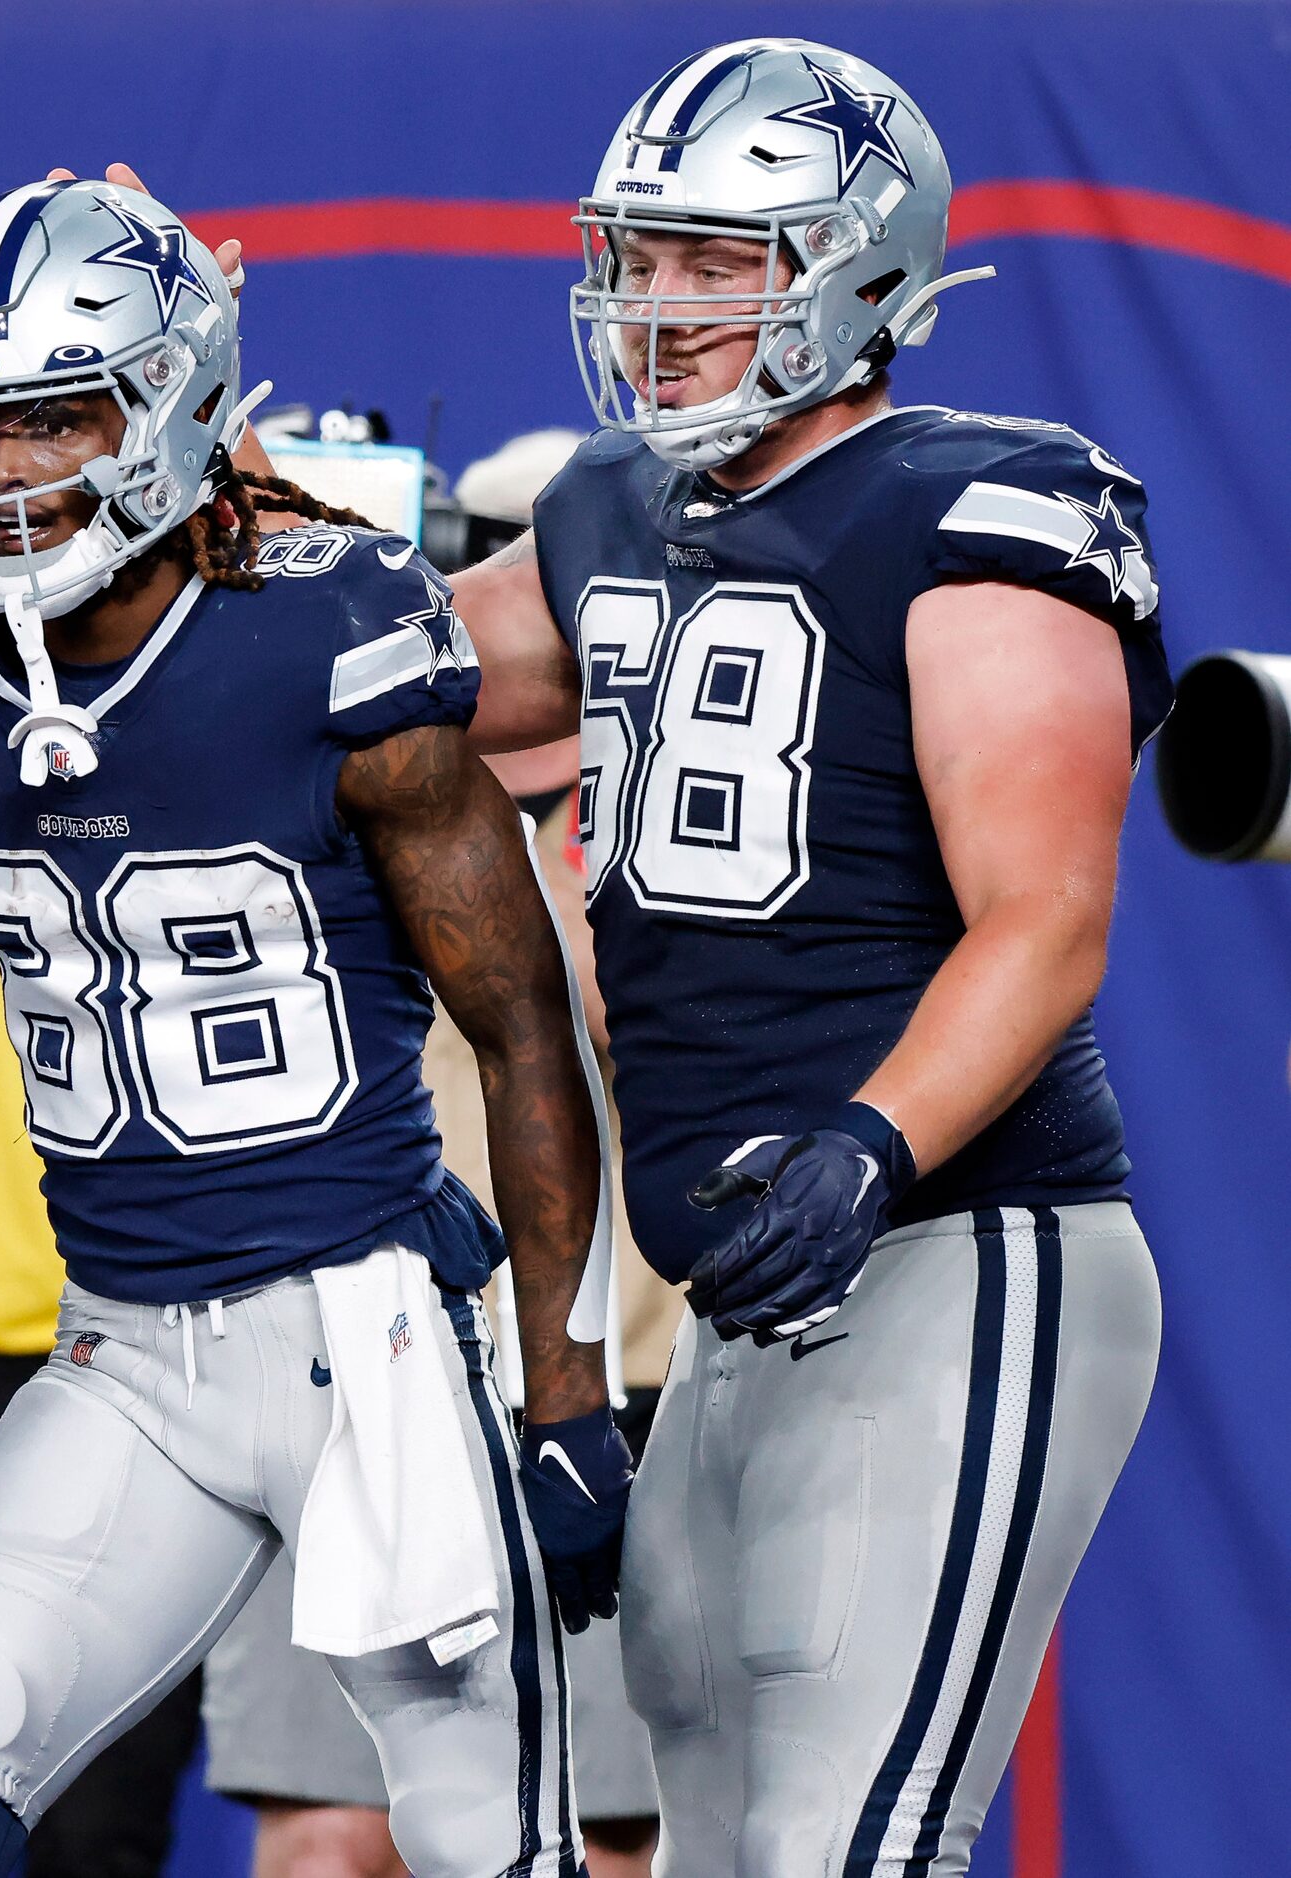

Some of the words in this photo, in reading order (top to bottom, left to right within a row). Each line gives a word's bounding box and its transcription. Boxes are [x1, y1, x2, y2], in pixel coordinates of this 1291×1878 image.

[615, 181, 664, 196] COWBOYS
[575, 576, 827, 920] 68
[37, 813, 131, 839] COWBOYS
[392, 1328, 410, 1359] NFL
